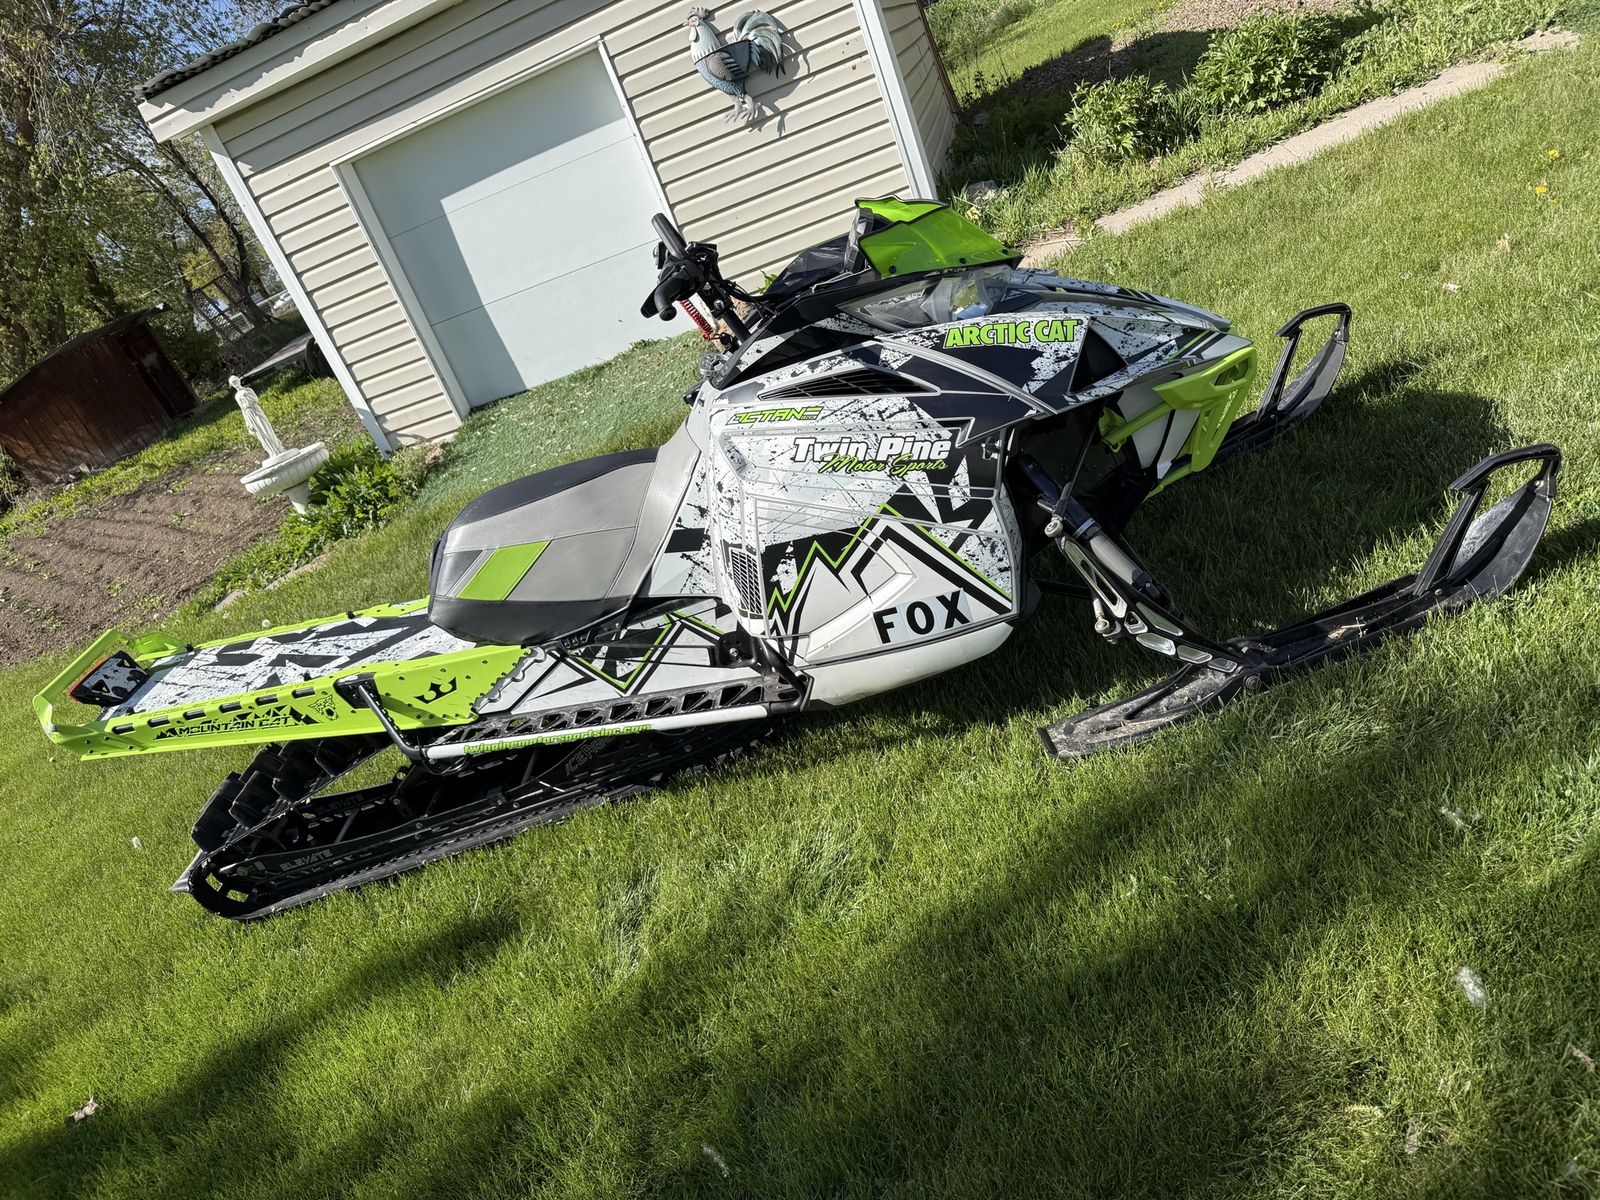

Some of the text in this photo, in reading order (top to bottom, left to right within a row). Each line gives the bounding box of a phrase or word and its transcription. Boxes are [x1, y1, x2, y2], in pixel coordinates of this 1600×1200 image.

[944, 319, 1078, 348] ARCTIC CAT
[726, 405, 825, 425] OCTANE
[794, 435, 951, 462] Twin Pine
[818, 453, 949, 476] Motor Sports
[873, 590, 971, 644] FOX
[178, 716, 291, 735] MOUNTAIN CAT
[464, 724, 652, 754] twinpinemotorsportsinc.com
